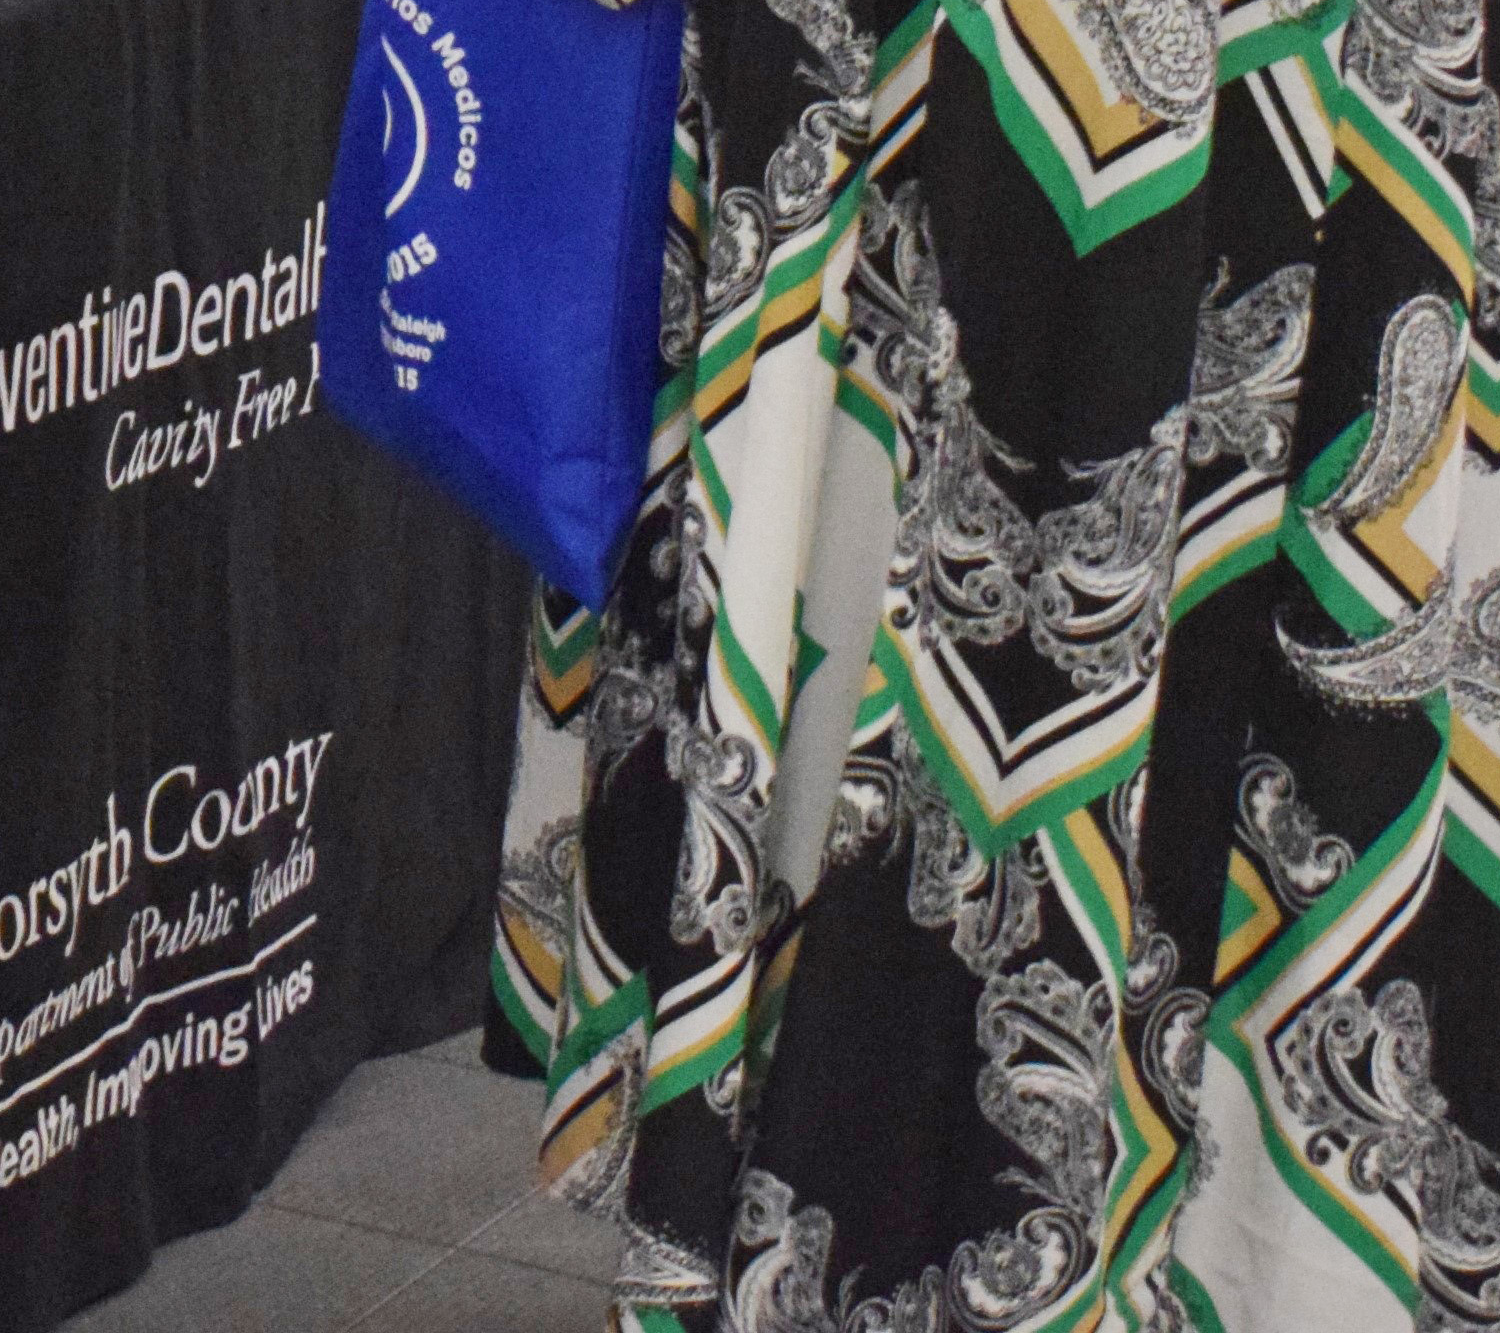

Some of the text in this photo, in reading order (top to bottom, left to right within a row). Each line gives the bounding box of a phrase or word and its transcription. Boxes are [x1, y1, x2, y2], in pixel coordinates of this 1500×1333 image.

[387, 232, 439, 284] 015
[106, 402, 221, 493] Cavity
[227, 366, 297, 451] Free
[144, 731, 333, 865] County
[118, 914, 141, 1004] of
[137, 882, 240, 969] Public
[248, 827, 317, 928] Health
[84, 1002, 248, 1128] Improving
[256, 958, 314, 1042] Lives
